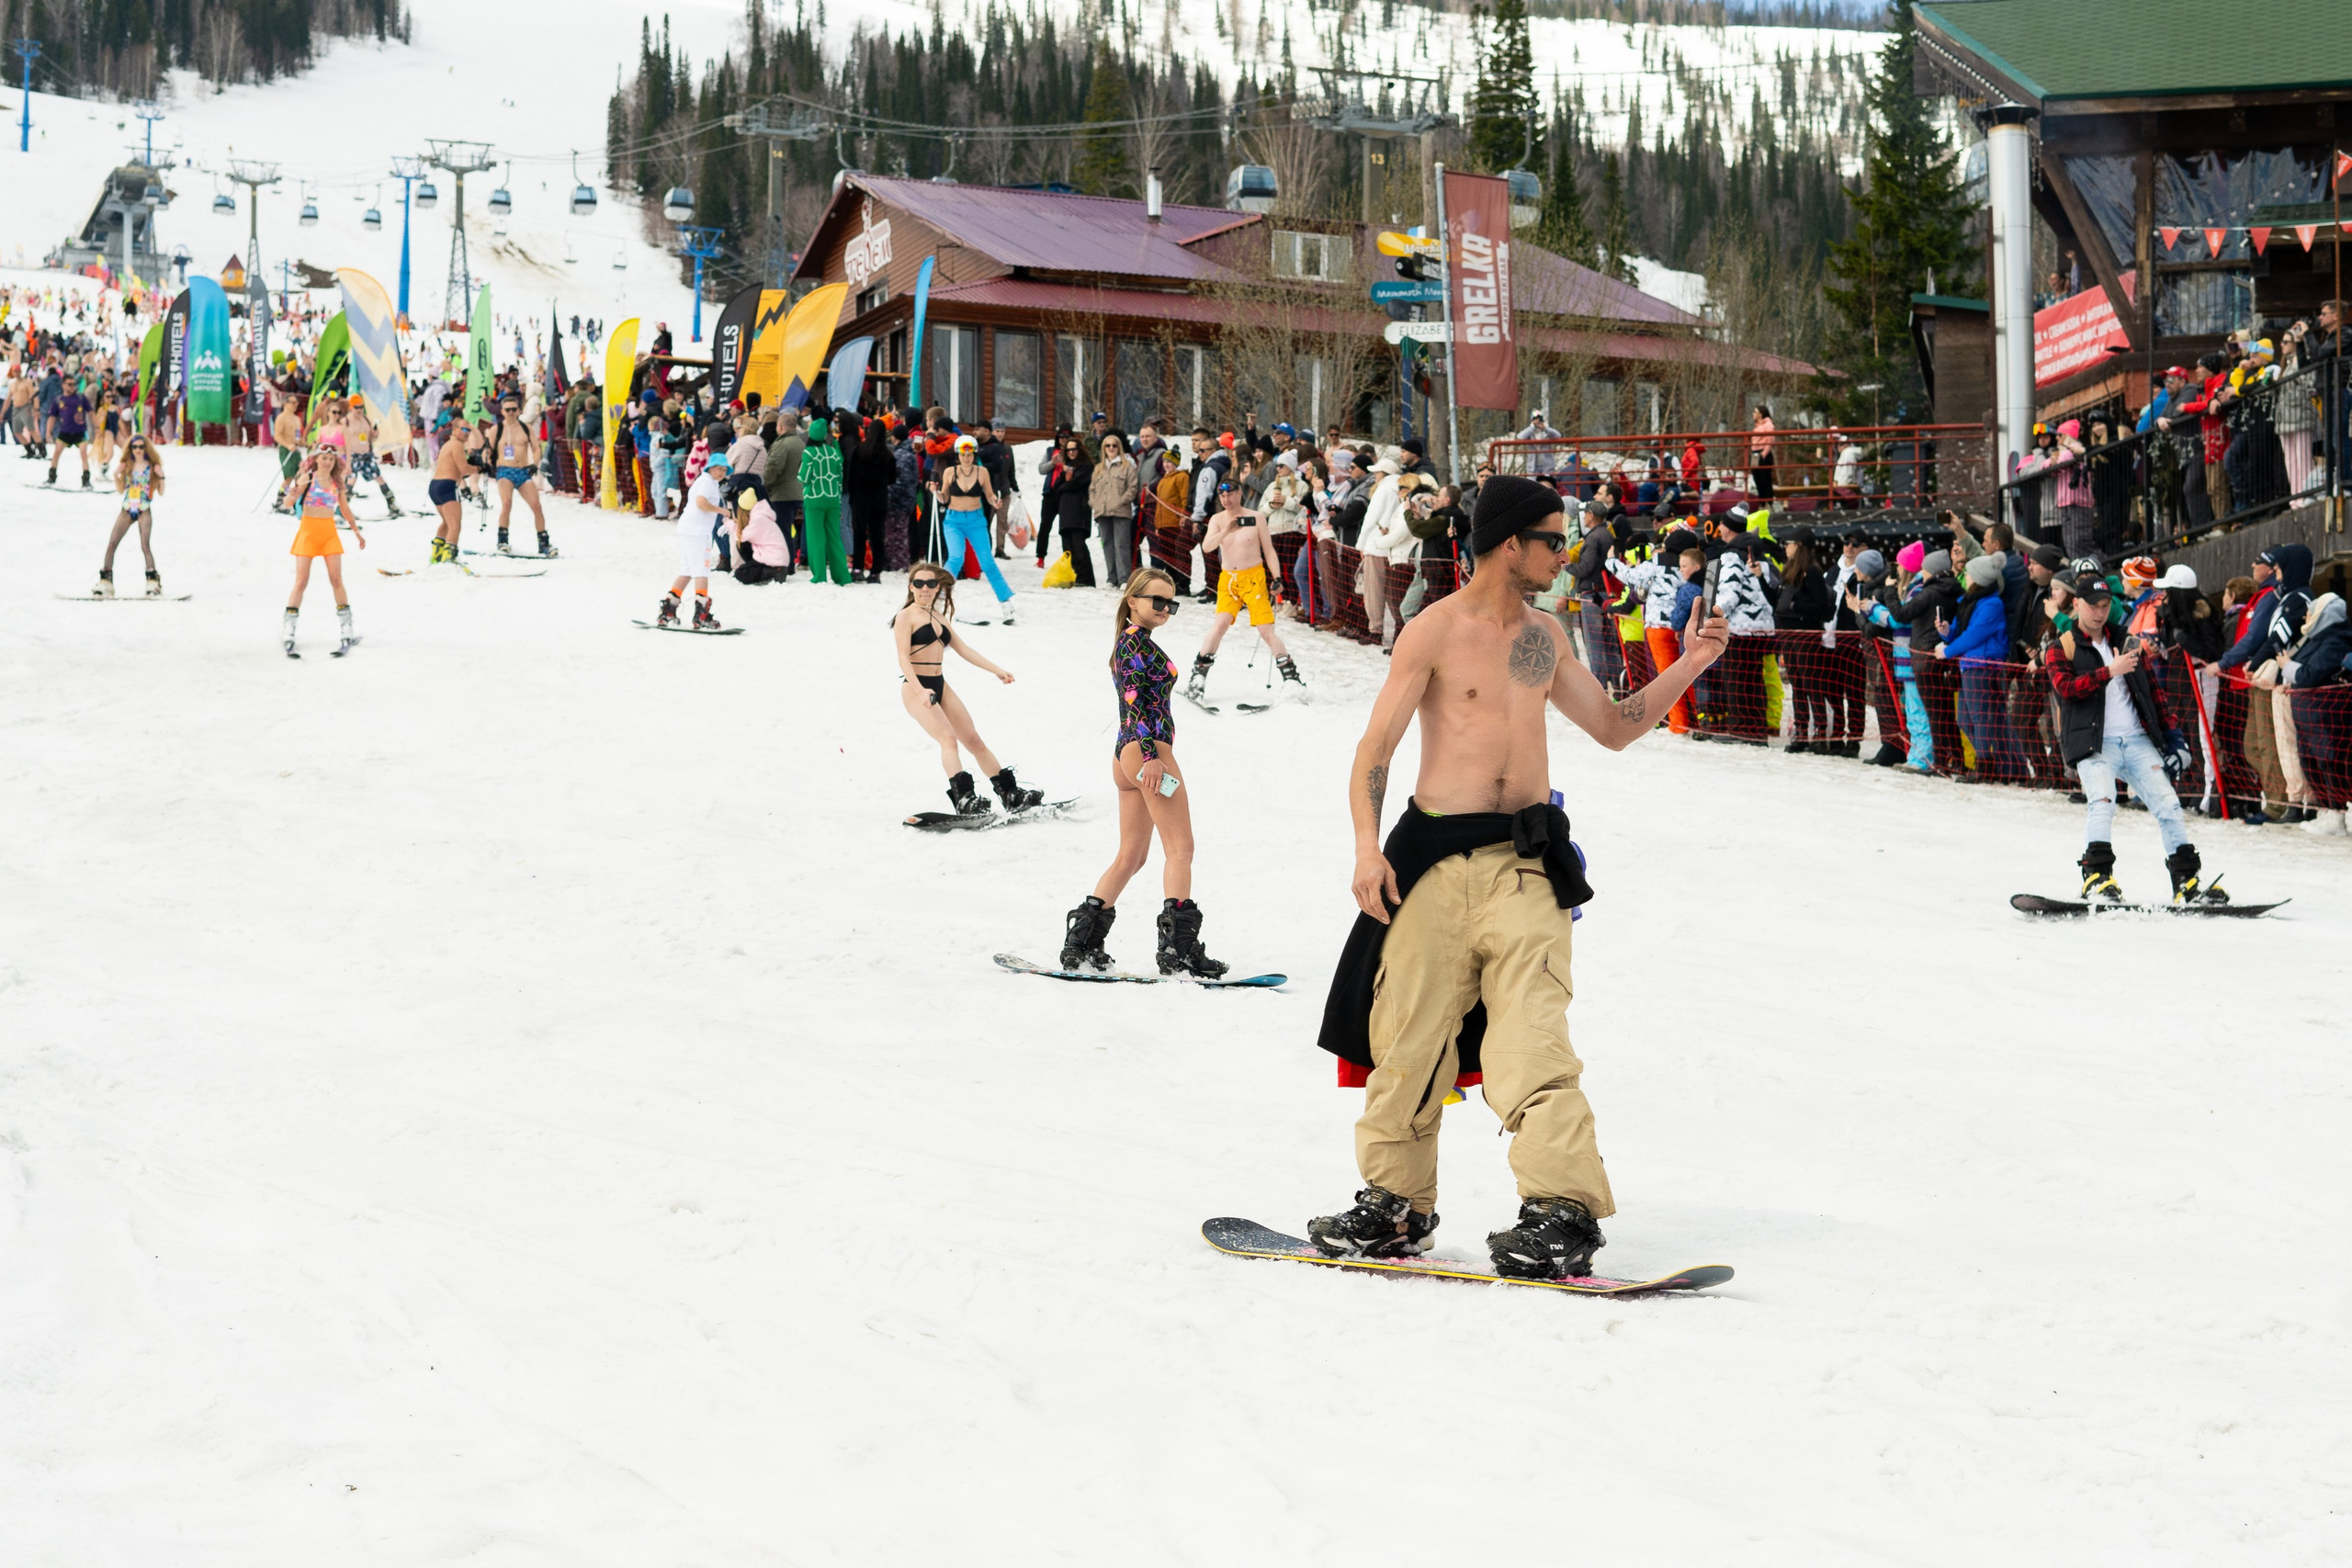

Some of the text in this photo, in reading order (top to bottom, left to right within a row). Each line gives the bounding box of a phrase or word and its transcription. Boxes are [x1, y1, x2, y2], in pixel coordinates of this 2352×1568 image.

[1371, 153, 1385, 164] 13
[1461, 232, 1500, 344] GRELKA
[1399, 324, 1448, 336] ELIZABE
